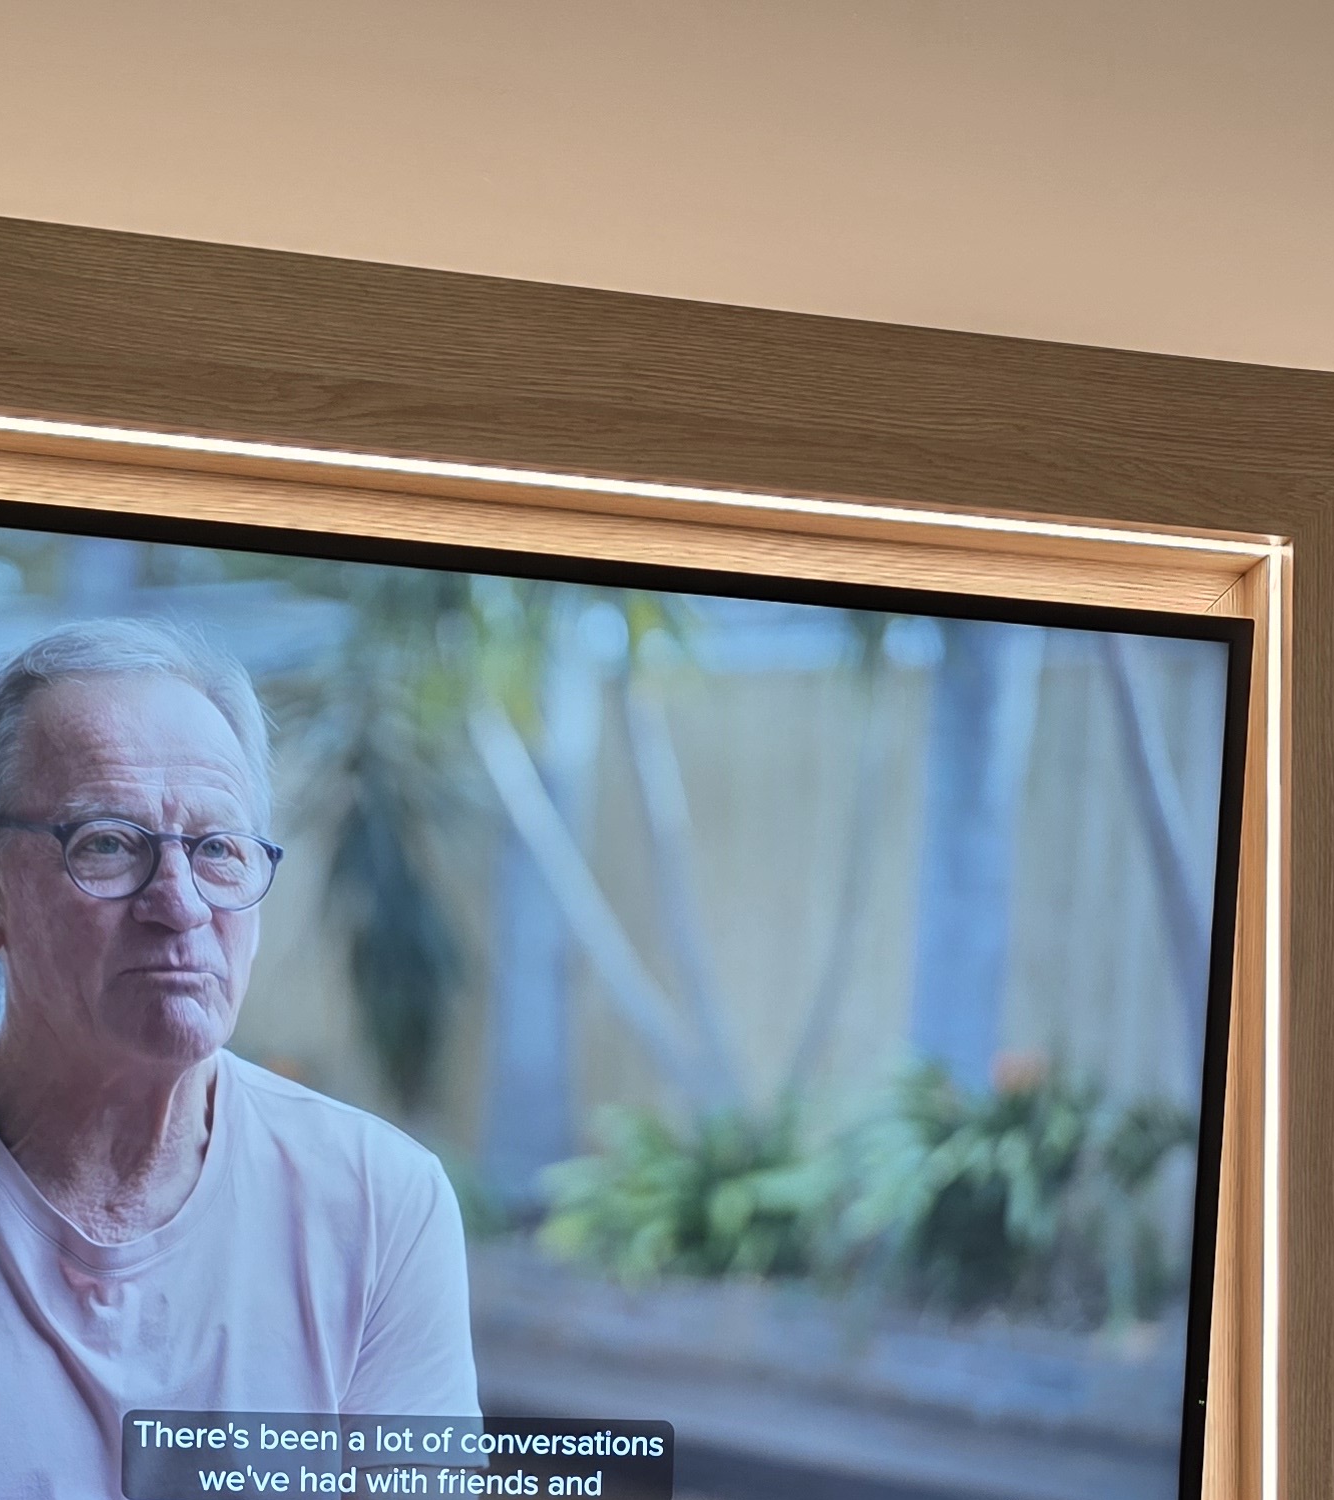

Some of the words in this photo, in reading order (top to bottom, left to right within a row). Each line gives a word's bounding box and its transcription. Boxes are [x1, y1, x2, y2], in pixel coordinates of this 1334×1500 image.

[133, 1420, 250, 1450] There's
[260, 1423, 338, 1450] been
[348, 1431, 365, 1451] a
[376, 1425, 414, 1452] lot
[422, 1427, 454, 1453] of
[460, 1430, 664, 1457] conversations
[198, 1464, 290, 1492] we've
[300, 1466, 357, 1493] had
[366, 1467, 427, 1494] with
[437, 1468, 539, 1496] friends
[548, 1470, 602, 1497] and
